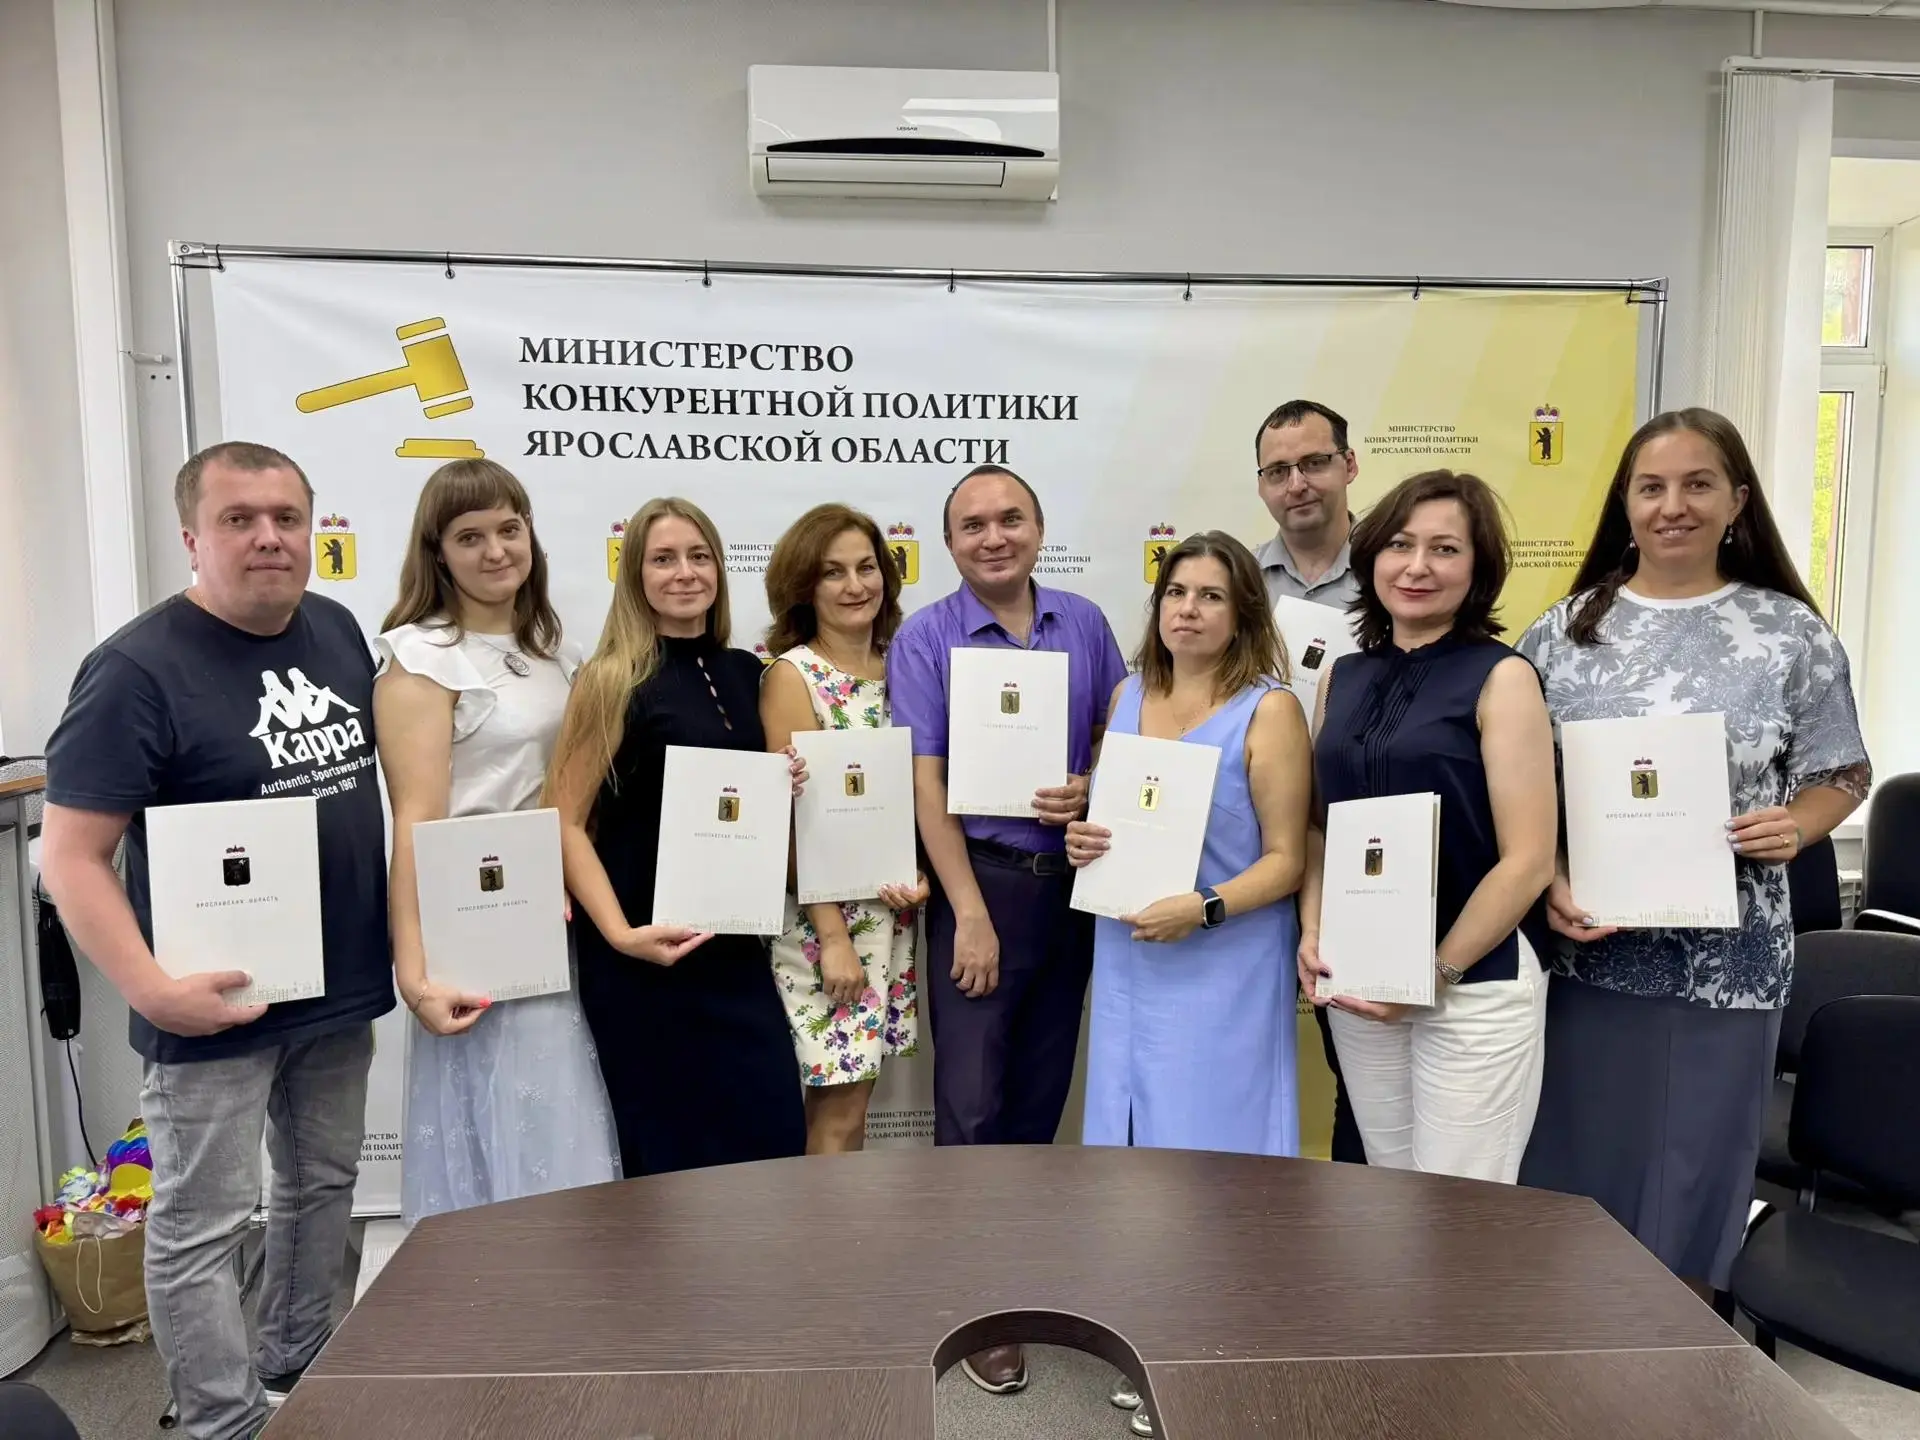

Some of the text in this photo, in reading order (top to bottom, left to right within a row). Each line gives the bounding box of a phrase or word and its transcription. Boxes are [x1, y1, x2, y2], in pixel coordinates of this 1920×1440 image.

[519, 336, 853, 372] МИНИСТЕРСТВО
[522, 383, 1079, 420] КОНКУРЕНТНОЙ ПОЛИТИКИ
[523, 429, 1010, 464] ЯРОСЛАВСКОЙ ОБЛАСТИ
[1364, 434, 1431, 443] КОНКУРЕНТНОЙ
[1371, 445, 1471, 454] ЯРОСЛАВСКОЙ ОБЛАСТИ
[1044, 566, 1084, 574] ОБЛАСТИ
[259, 717, 366, 769] Kappa
[261, 774, 311, 796] Authentic
[311, 760, 360, 782] Sportswear
[312, 776, 358, 800] Since 1967
